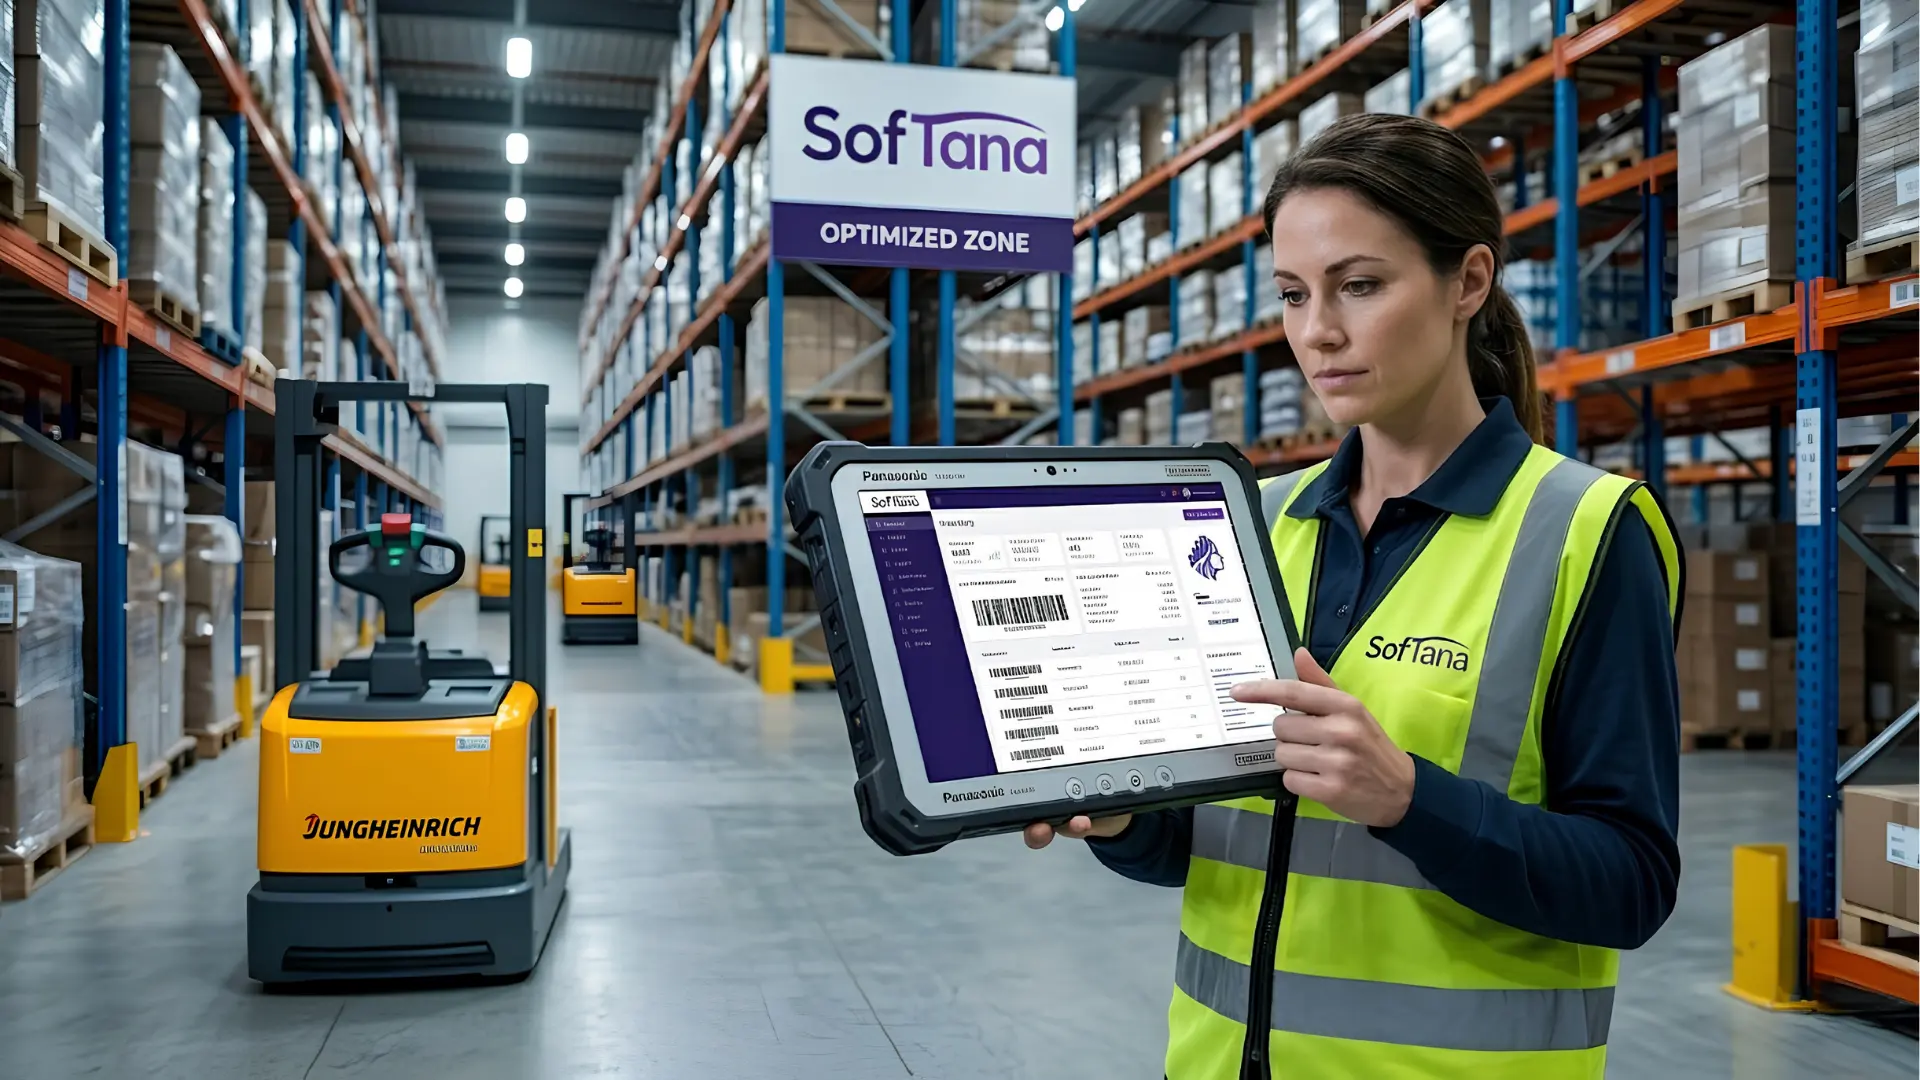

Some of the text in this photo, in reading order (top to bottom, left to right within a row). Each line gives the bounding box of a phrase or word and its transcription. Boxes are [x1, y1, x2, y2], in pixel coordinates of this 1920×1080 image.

[801, 105, 1048, 175] SofTana
[820, 222, 1030, 253] OPTIMIZED ZONE
[1365, 635, 1470, 672] SofTana
[302, 813, 482, 840] JUNGHEINRICH
